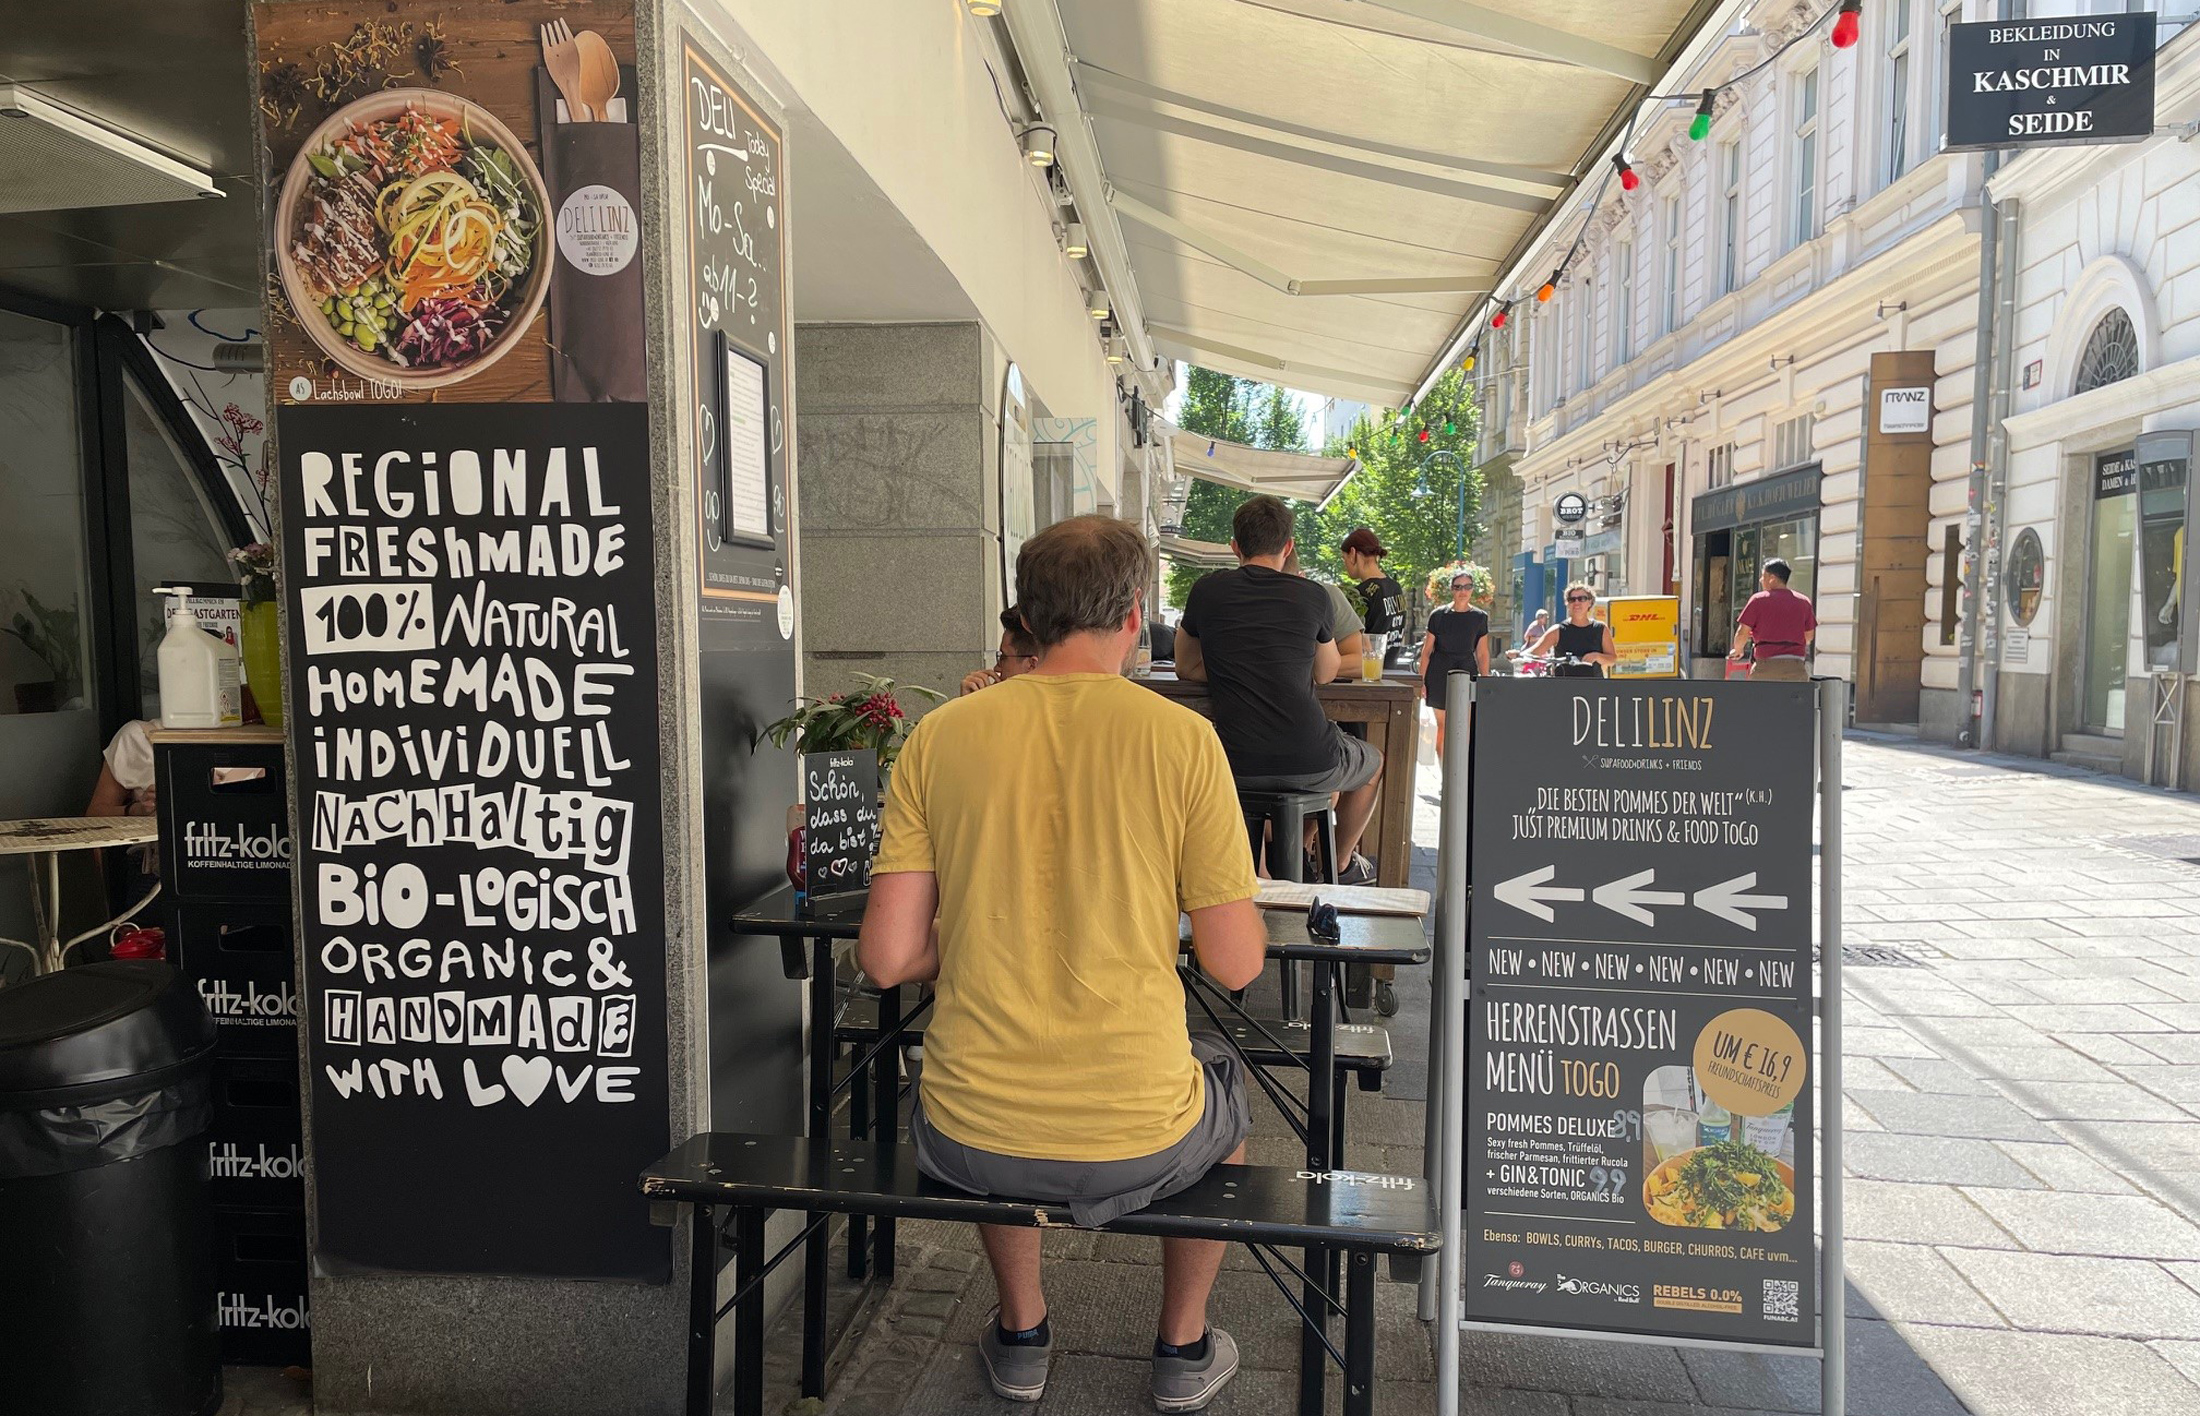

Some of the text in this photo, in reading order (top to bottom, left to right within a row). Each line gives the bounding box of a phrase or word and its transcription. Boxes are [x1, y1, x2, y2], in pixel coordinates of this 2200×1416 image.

[1989, 22, 2116, 44] BEKLEIDUNG
[2044, 49, 2060, 61] IN
[1973, 64, 2131, 93] KASCHMIR
[2046, 95, 2056, 105] &
[2008, 110, 2093, 136] SEIDE
[744, 130, 770, 174] Today
[745, 165, 775, 204] Special
[313, 379, 364, 401] Lachsbowl
[1886, 391, 1925, 403] FRANZ
[315, 580, 630, 658] 100% NATURAL
[1629, 613, 1659, 622] DHL
[307, 652, 634, 722] HOMEMADE
[1672, 759, 1702, 771] FRIENDS
[1564, 788, 1609, 812] BESTEN
[1613, 790, 1668, 815] POMMES
[1672, 791, 1697, 815] DER
[1745, 788, 1773, 805] (K.H.)
[810, 806, 876, 829] dass du
[1512, 815, 1544, 840] JUST
[1547, 815, 1609, 841] PREMIUM
[1612, 817, 1663, 843] DRINKS
[1667, 821, 1681, 843] &
[1684, 820, 1719, 844] FOOD
[810, 837, 834, 856] da
[839, 826, 866, 851] bist
[187, 860, 254, 869] KOFFEINHALTIGE
[1489, 948, 1795, 988] NEW NEW NEW NEW NEW NEW
[1486, 1002, 1676, 1051] HERRENSTRASSEN
[1713, 1030, 1792, 1083] UM € 16,9
[325, 1057, 443, 1101] WITH
[1486, 1049, 1620, 1099] MENÜ TOGO
[1707, 1060, 1781, 1099] FREUNDSCHAFTSPREIS
[1487, 1112, 1616, 1138] POMMES DELUXE
[1487, 1137, 1604, 1155] Sexy fresh Pommes, Trüffelöl,
[1487, 1149, 1628, 1168] frischer Parmesan, frittierter Rucola
[1500, 1164, 1586, 1188] GIN&TONIC
[1487, 1186, 1625, 1204] verschiedene Sorten, ORGANICS Bio
[1483, 1228, 1798, 1263] Ebenso: BOWLS, CURRYs, TACOS, BURGER, CHURROS, CAFE uvm...
[1483, 1273, 1743, 1302] Tanqueray ORGANICS REBELS 0.0%
[217, 1292, 311, 1330] fritz-kol
[1017, 1328, 1040, 1340] PUMA
